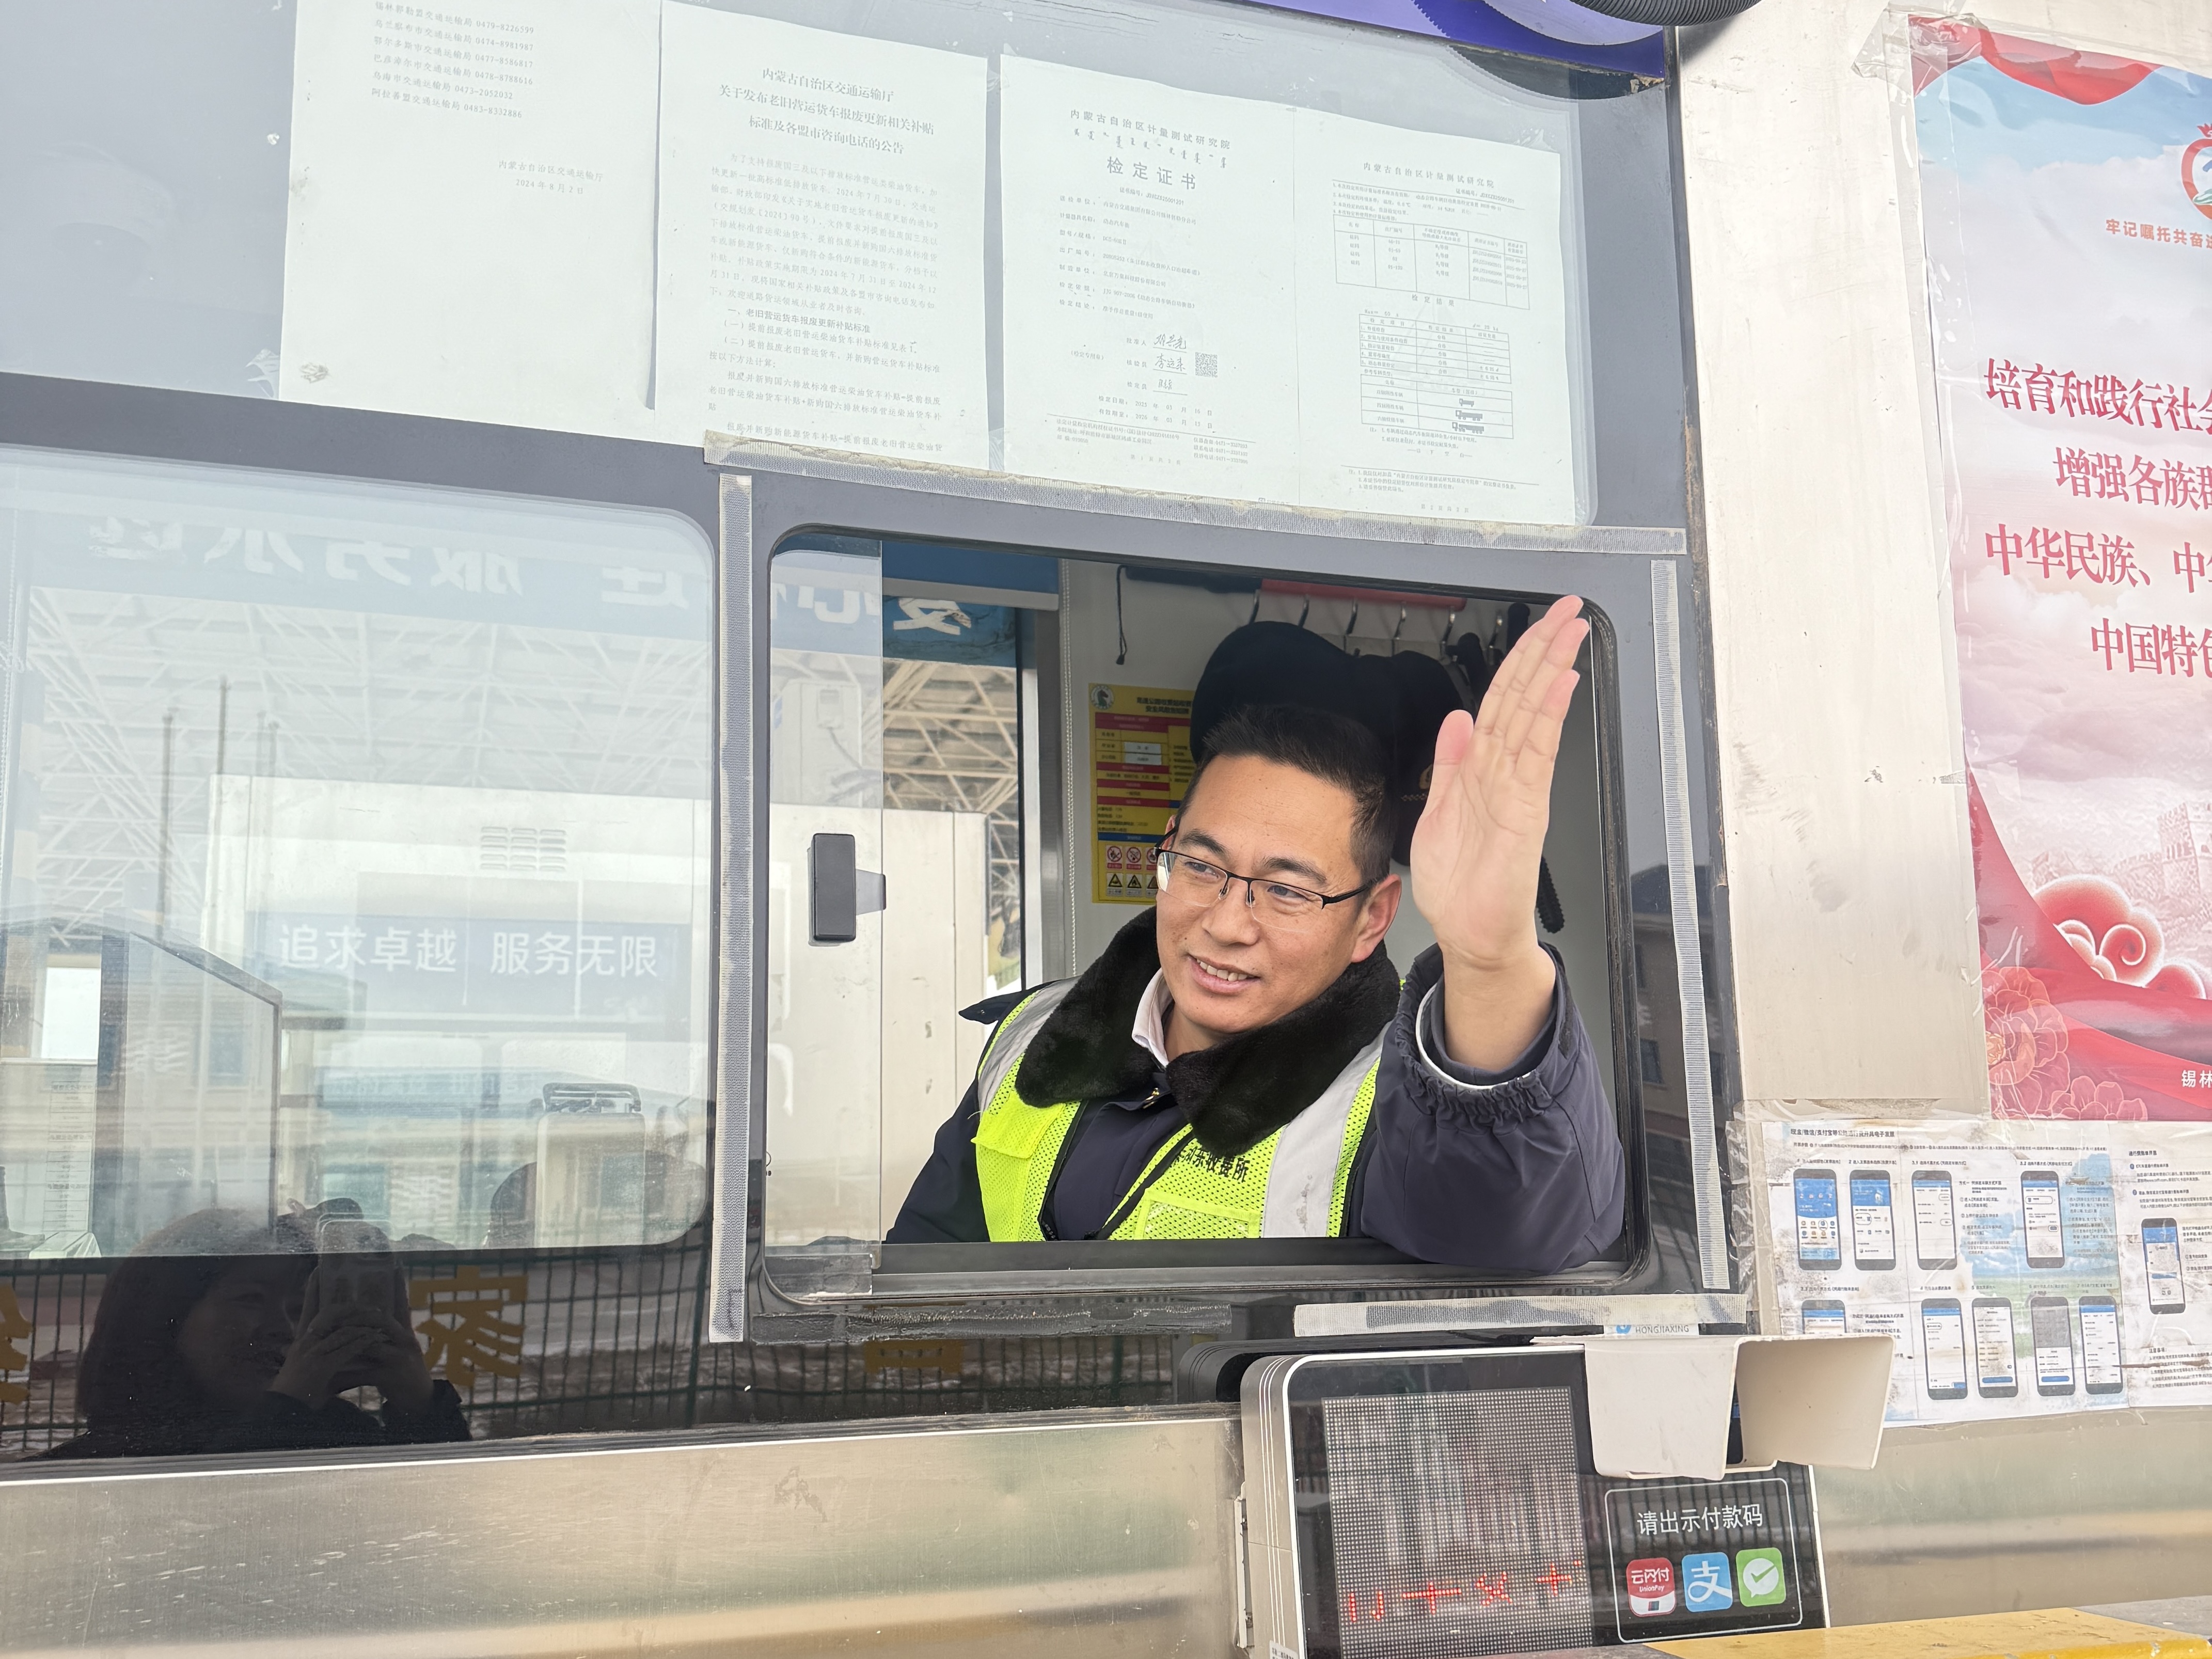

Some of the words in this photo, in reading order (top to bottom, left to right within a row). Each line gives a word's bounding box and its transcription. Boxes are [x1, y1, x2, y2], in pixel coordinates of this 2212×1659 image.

[763, 68, 894, 102] 内蒙古自治区交通运输厅
[720, 85, 934, 135] 关于发布老旧营运货车报废更新相关补贴
[749, 115, 904, 154] 标准及各盟市咨询电话的公告
[1070, 109, 1230, 149] 内蒙古自治区计量测试研究院
[1107, 156, 1196, 190] 检定证书
[1985, 523, 2212, 593] 中华民族、中
[279, 923, 457, 974] 追求卓越
[489, 931, 658, 977] 服务无限
[1635, 1324, 1689, 1334] HONGJIAXING
[1637, 1504, 1763, 1536] 请出示付款码
[1631, 1567, 1670, 1584] 云闪付
